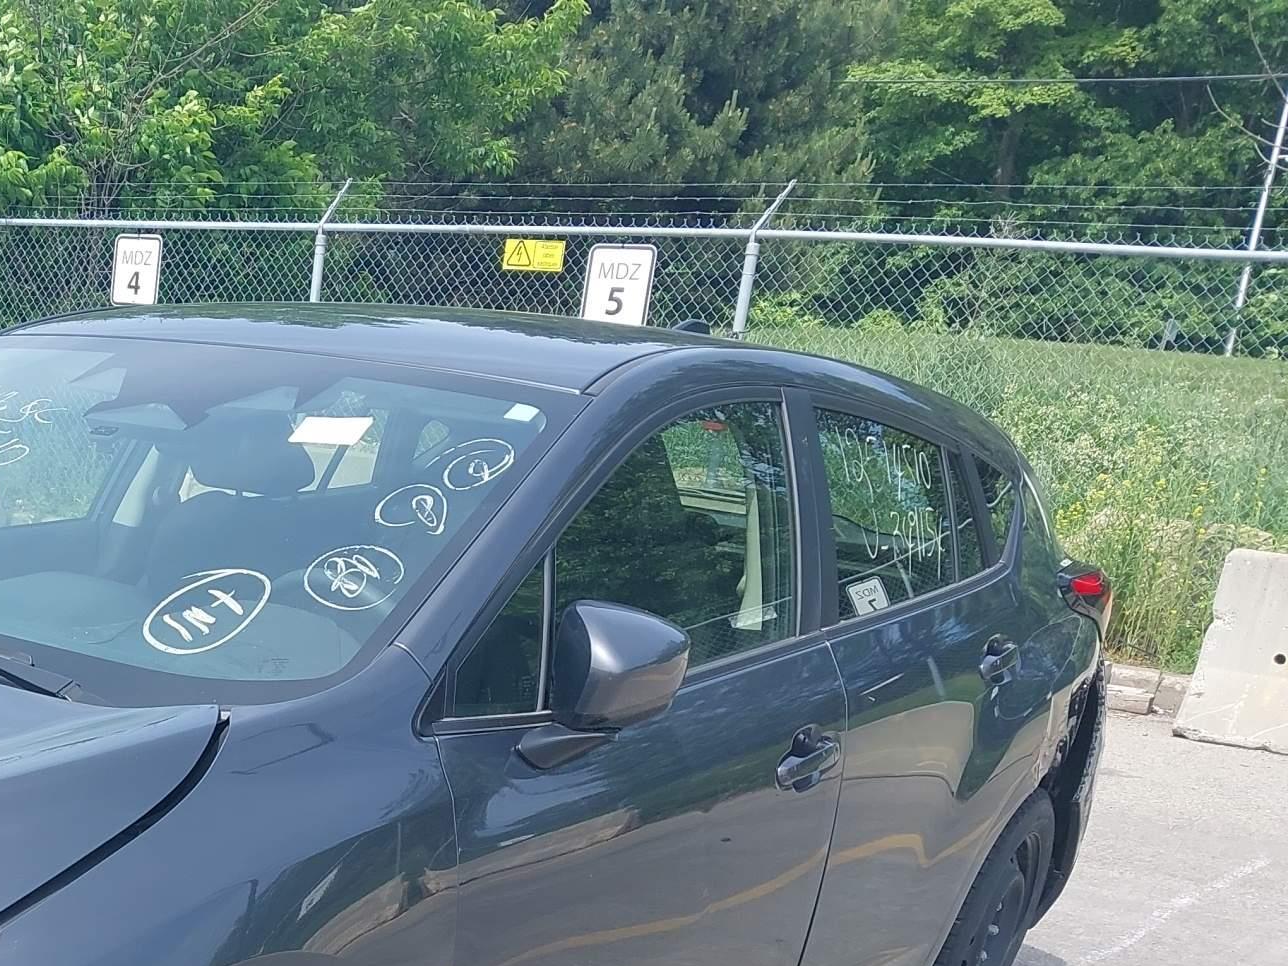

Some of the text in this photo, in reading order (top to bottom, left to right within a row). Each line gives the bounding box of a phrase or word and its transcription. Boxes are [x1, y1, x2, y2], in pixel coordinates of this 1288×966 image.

[121, 249, 153, 266] MDZ
[598, 262, 643, 281] MDZ
[127, 271, 141, 296] 4
[604, 286, 625, 316] 5
